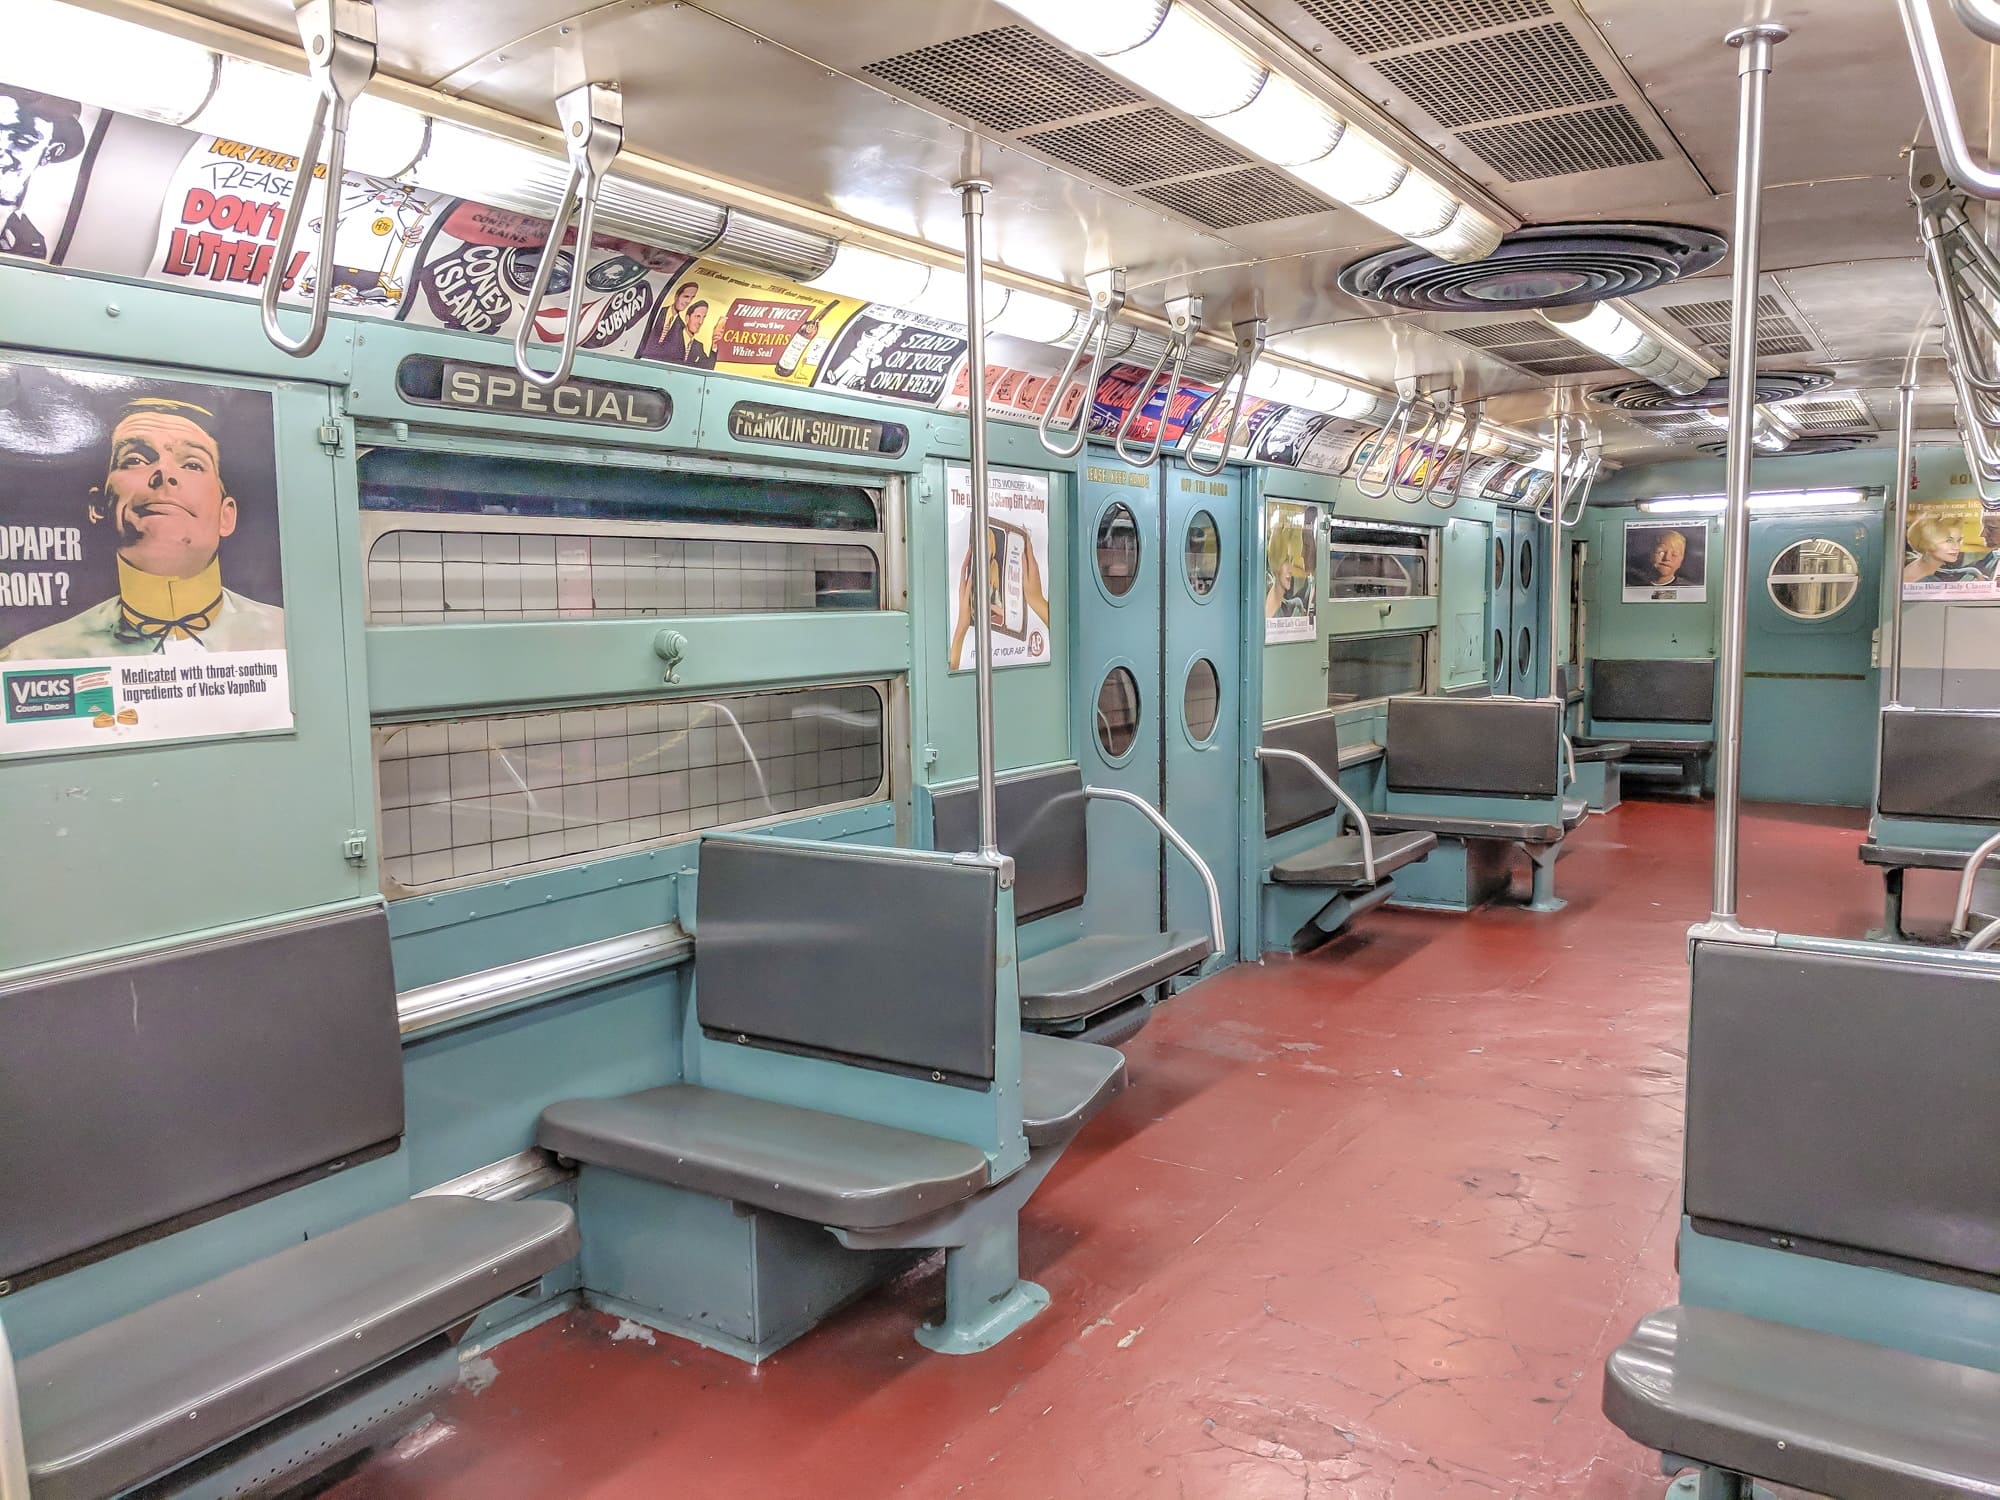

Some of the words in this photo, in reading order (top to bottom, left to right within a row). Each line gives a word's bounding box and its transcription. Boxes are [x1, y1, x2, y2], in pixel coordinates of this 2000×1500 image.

[208, 137, 252, 161] FOR
[200, 161, 294, 198] PLEASE
[181, 187, 286, 241] DON'T
[463, 245, 511, 315] CONEY
[433, 258, 492, 333] ISLAND
[611, 287, 637, 310] GO
[595, 287, 647, 340] SUBWAY
[733, 304, 769, 319] THINK
[767, 307, 808, 321] TWICE!
[723, 329, 791, 346] CARSTAIRS
[773, 323, 786, 331] buy
[732, 345, 755, 357] White
[755, 347, 774, 358] Seal
[900, 333, 960, 352] STAND
[885, 350, 914, 369] ON
[905, 353, 953, 374] YOUR
[870, 371, 908, 392] OWN
[901, 373, 948, 398] FEET!
[451, 371, 648, 424] SPECIAL
[985, 407, 1026, 419] PPORTUNITY
[951, 488, 965, 506] The
[994, 491, 1013, 512] Stamp
[1014, 493, 1024, 510] Gift
[1024, 494, 1045, 514] Catalog
[993, 648, 1000, 657] AT
[1001, 647, 1013, 656] YOUR
[121, 666, 177, 685] Medicated
[180, 665, 203, 680] with
[206, 662, 278, 679] throat-soothing
[11, 679, 71, 704] VICKS
[122, 685, 183, 704] ingredients
[186, 682, 197, 698] of
[199, 682, 226, 697] Vicks
[227, 679, 267, 697] VapoRub
